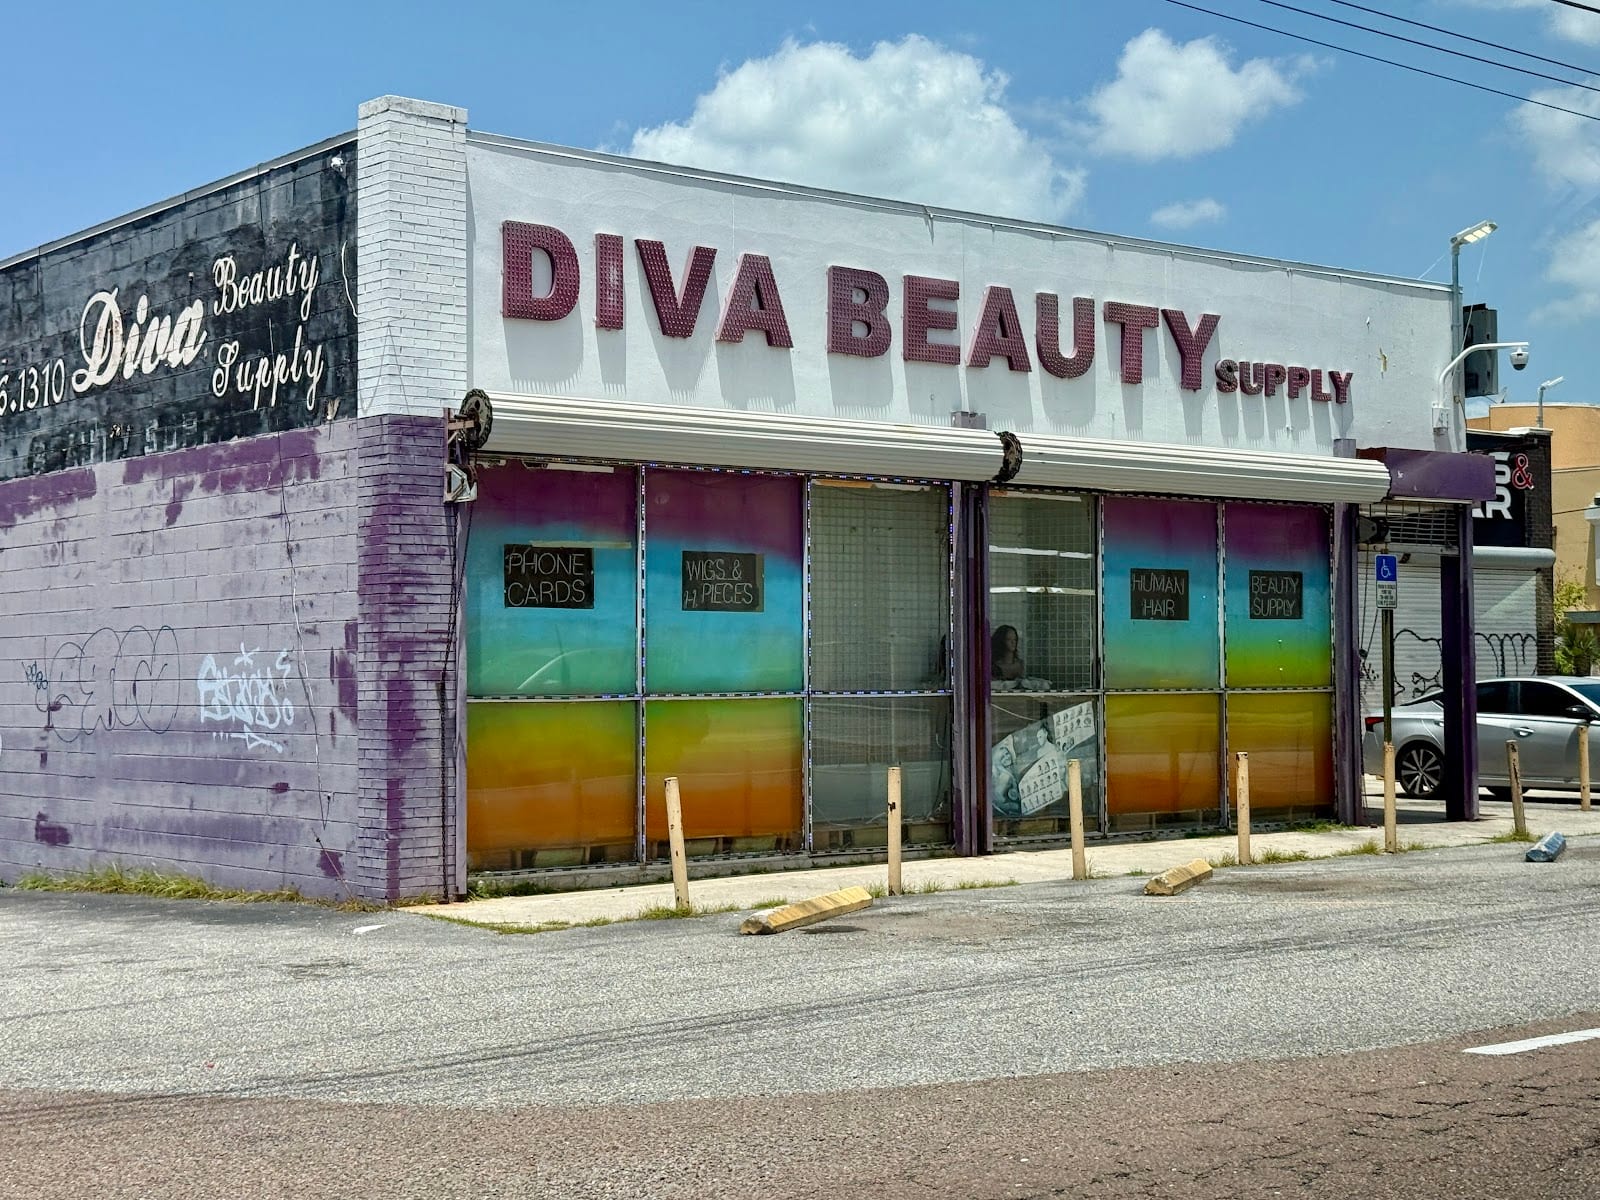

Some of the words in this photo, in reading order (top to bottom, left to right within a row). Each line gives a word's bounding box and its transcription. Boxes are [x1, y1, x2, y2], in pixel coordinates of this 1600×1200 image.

[213, 243, 319, 321] Beauty
[502, 219, 793, 348] DIVA
[827, 265, 1222, 391] BEAUTY
[1215, 359, 1354, 404] SUPPLY
[71, 287, 207, 393] Diva
[213, 325, 324, 411] Supply
[1512, 453, 1535, 490] &
[1472, 486, 1513, 519] R
[507, 551, 585, 576] PHONE
[686, 559, 726, 581] WIGS
[732, 559, 743, 580] &
[507, 579, 586, 606] CARDS
[701, 582, 753, 605] PIECES
[1131, 572, 1185, 595] HUMAN
[1251, 575, 1299, 594] BEAUTY
[1142, 598, 1175, 617] HAIR
[1253, 597, 1297, 617] SUPPLY
